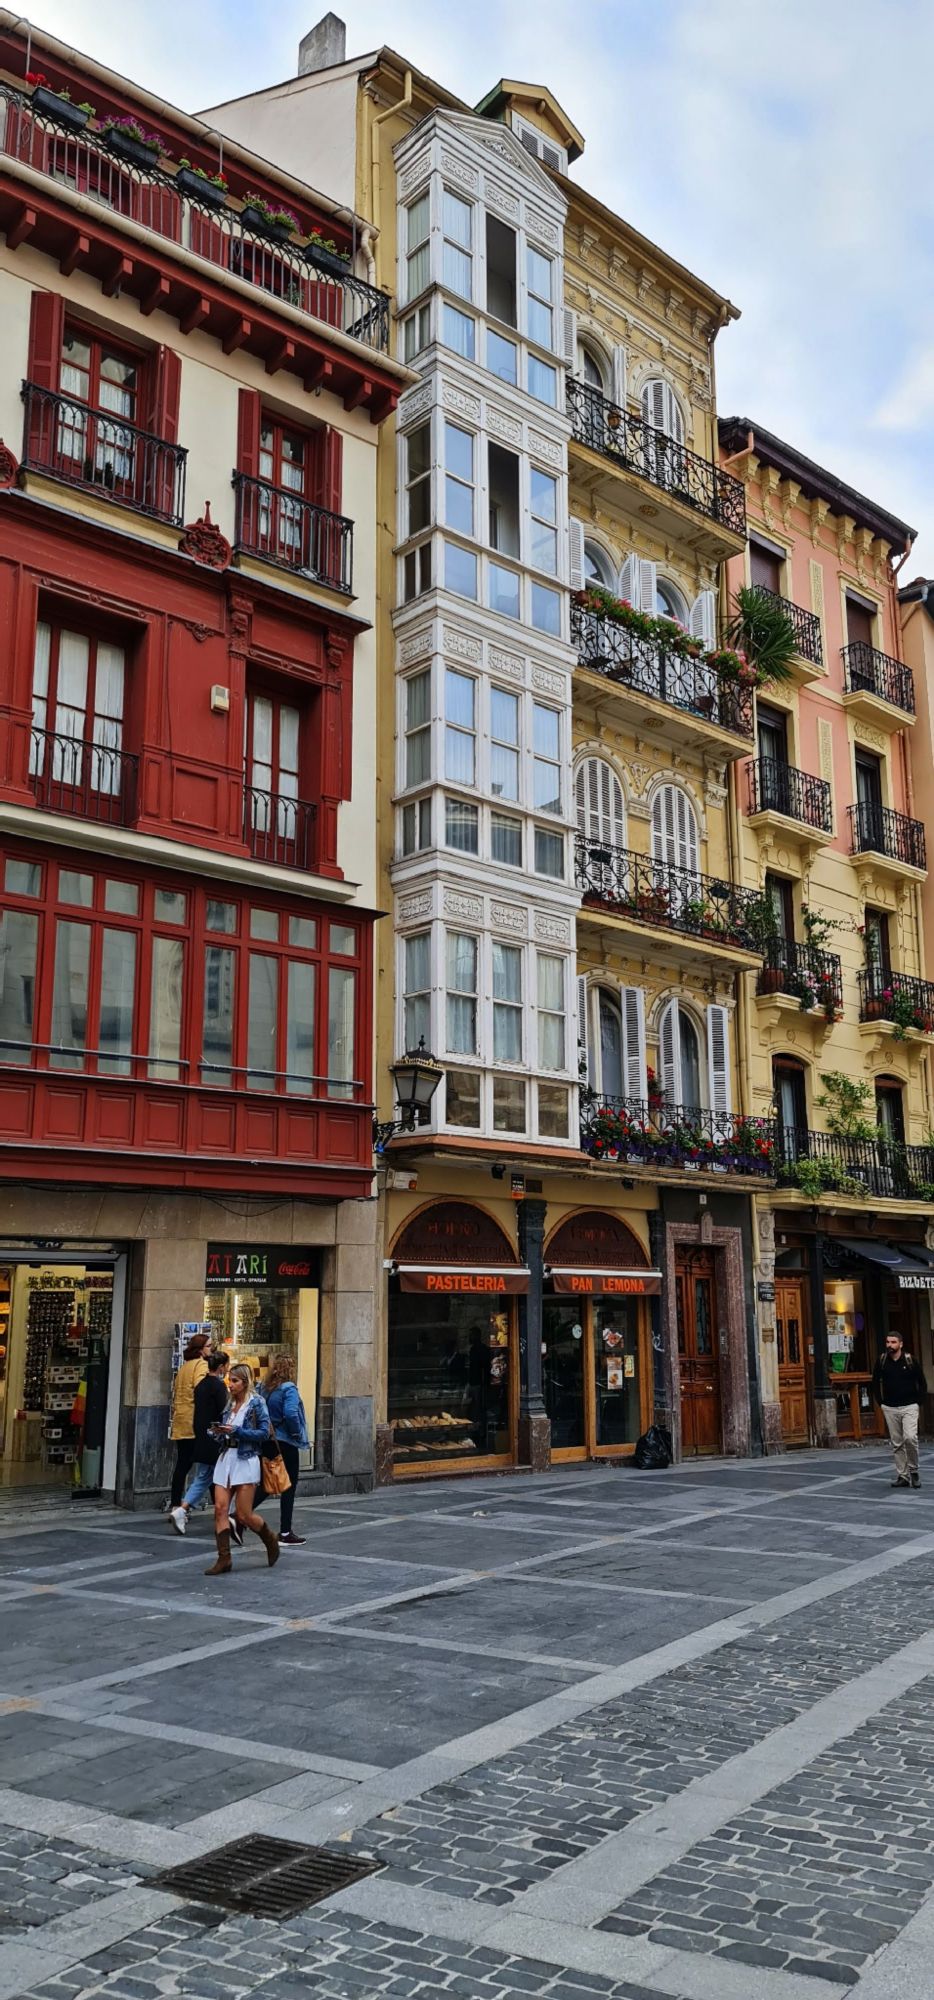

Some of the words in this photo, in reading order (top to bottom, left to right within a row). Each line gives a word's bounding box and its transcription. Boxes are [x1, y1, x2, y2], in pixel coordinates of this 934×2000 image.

[426, 1275, 506, 1292] PASTELERIA
[571, 1277, 593, 1291] PAN
[602, 1278, 645, 1292] LEMONA
